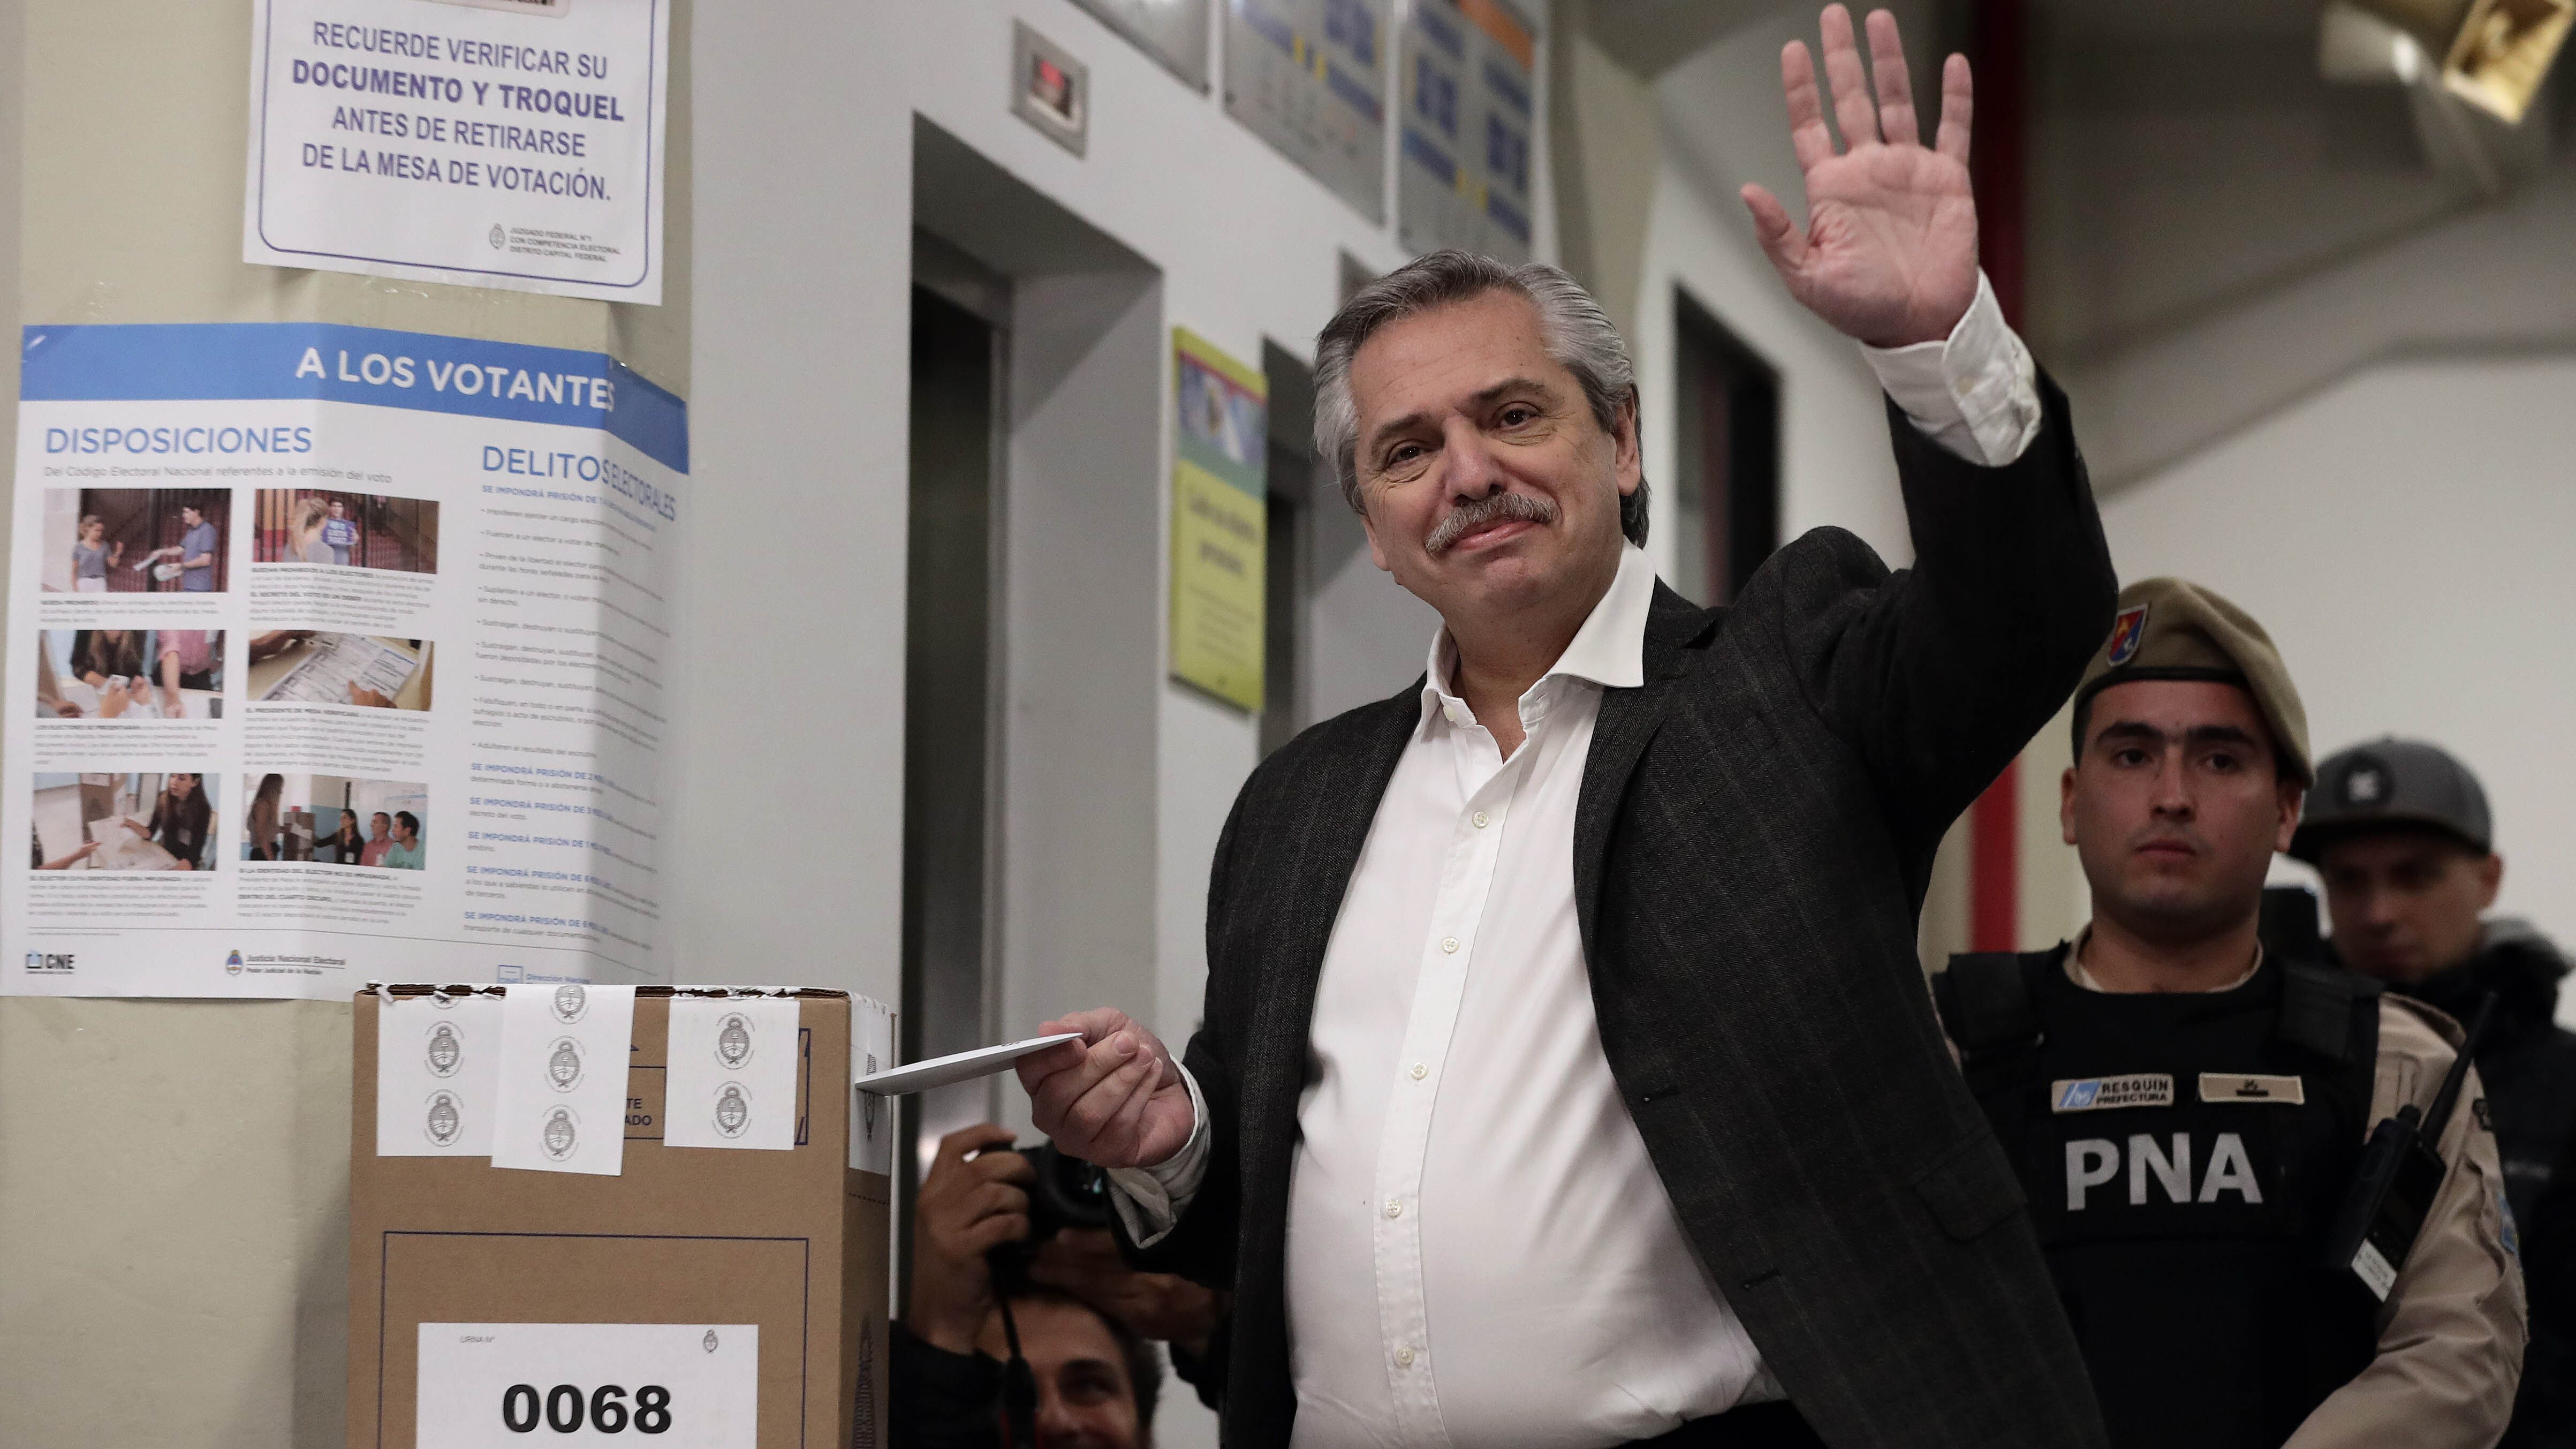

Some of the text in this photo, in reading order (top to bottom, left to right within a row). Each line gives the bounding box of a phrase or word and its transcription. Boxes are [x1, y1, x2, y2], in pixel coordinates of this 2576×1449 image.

[313, 21, 607, 79] RECUERDE VERIFICAR SU
[293, 59, 624, 122] DOCUMENTO Y TROQUEL
[332, 107, 586, 157] ANTES DE RETIRARSE
[303, 143, 612, 201] DE LA MESA DE VOTACIÓN.
[296, 346, 614, 412] A LOS VOTANTES
[46, 427, 312, 454] DISPOSICIONES
[44, 466, 63, 477] Del
[67, 466, 107, 479] Código
[111, 466, 160, 476] Electoral
[164, 466, 211, 477] Nacional
[216, 467, 273, 476] referentes
[287, 468, 297, 476] la
[300, 467, 343, 479] emisión
[347, 470, 363, 481] del
[366, 473, 393, 484] voto
[483, 446, 609, 485] DELITOS
[611, 462, 677, 522] ELECTORALES
[482, 485, 494, 494] SE
[472, 763, 482, 771] SE
[485, 764, 533, 775] IMPONDRÁ
[536, 768, 572, 779] PRISIÓN
[574, 772, 587, 780] DE
[470, 797, 587, 814] SE IMPONDRÁ PRISIÓN DE
[468, 831, 584, 848] SE IMPONDRÁ PRISIÓN DE
[466, 865, 582, 882] SE IMPONDRÁ PRISIÓN DE
[464, 911, 581, 927] SE IMPONDRÁ PRISIÓN DE
[2101, 1078, 2169, 1094] RESQUIN
[2096, 1092, 2167, 1106] PREFECTURA
[2065, 1131, 2263, 1212] PNA
[502, 1384, 672, 1435] 0068
